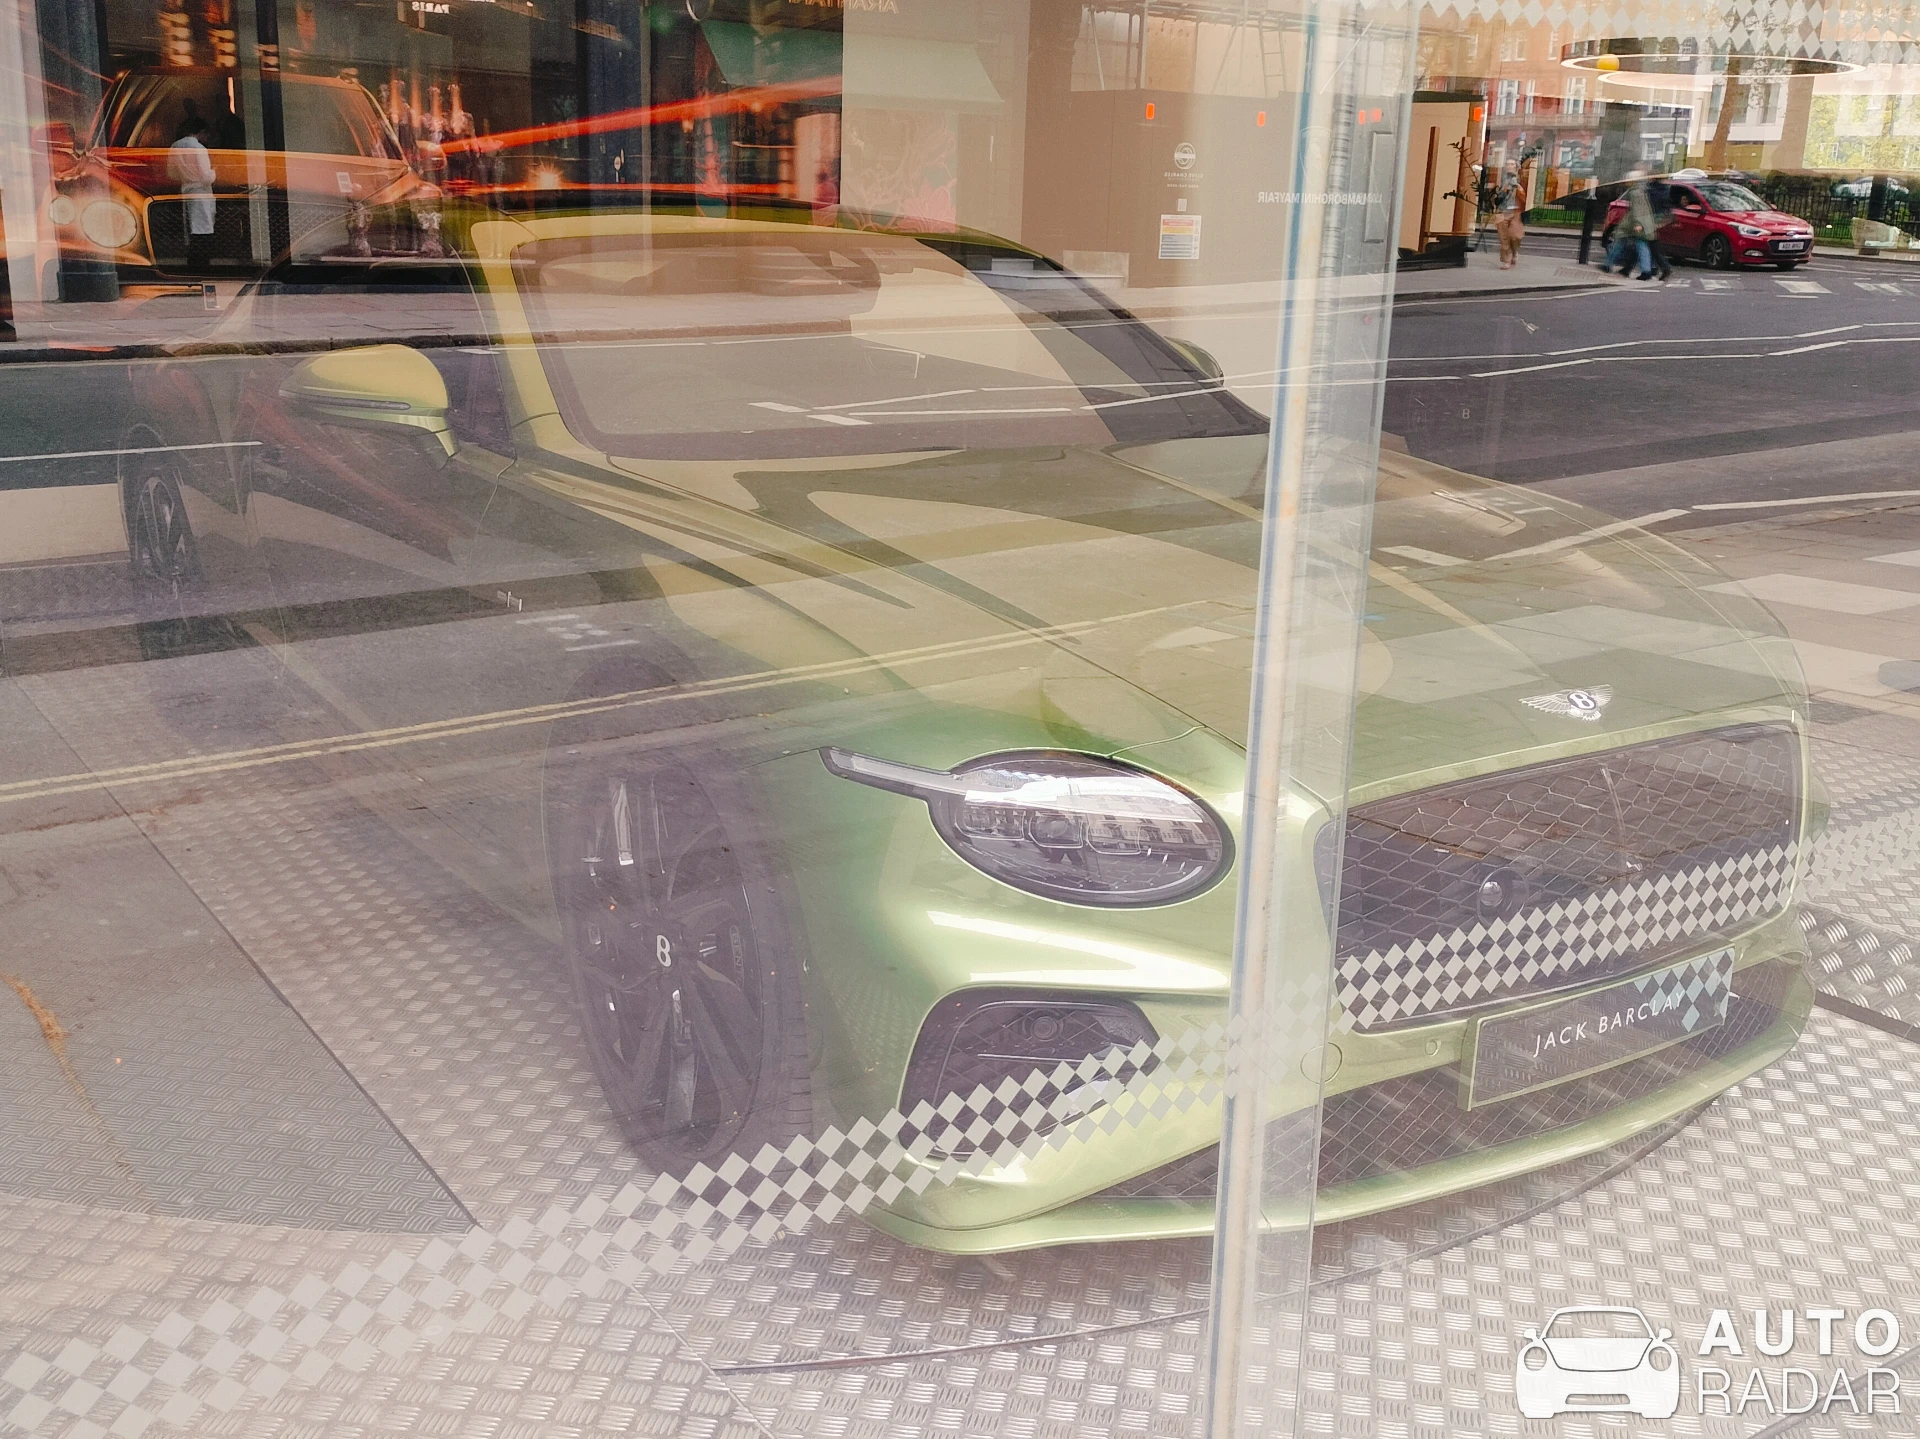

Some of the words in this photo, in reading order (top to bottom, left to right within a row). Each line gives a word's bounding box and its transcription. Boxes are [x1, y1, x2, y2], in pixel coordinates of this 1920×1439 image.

[656, 934, 671, 967] B
[1532, 1021, 1587, 1058] JACK
[1598, 990, 1686, 1034] BARCLAY
